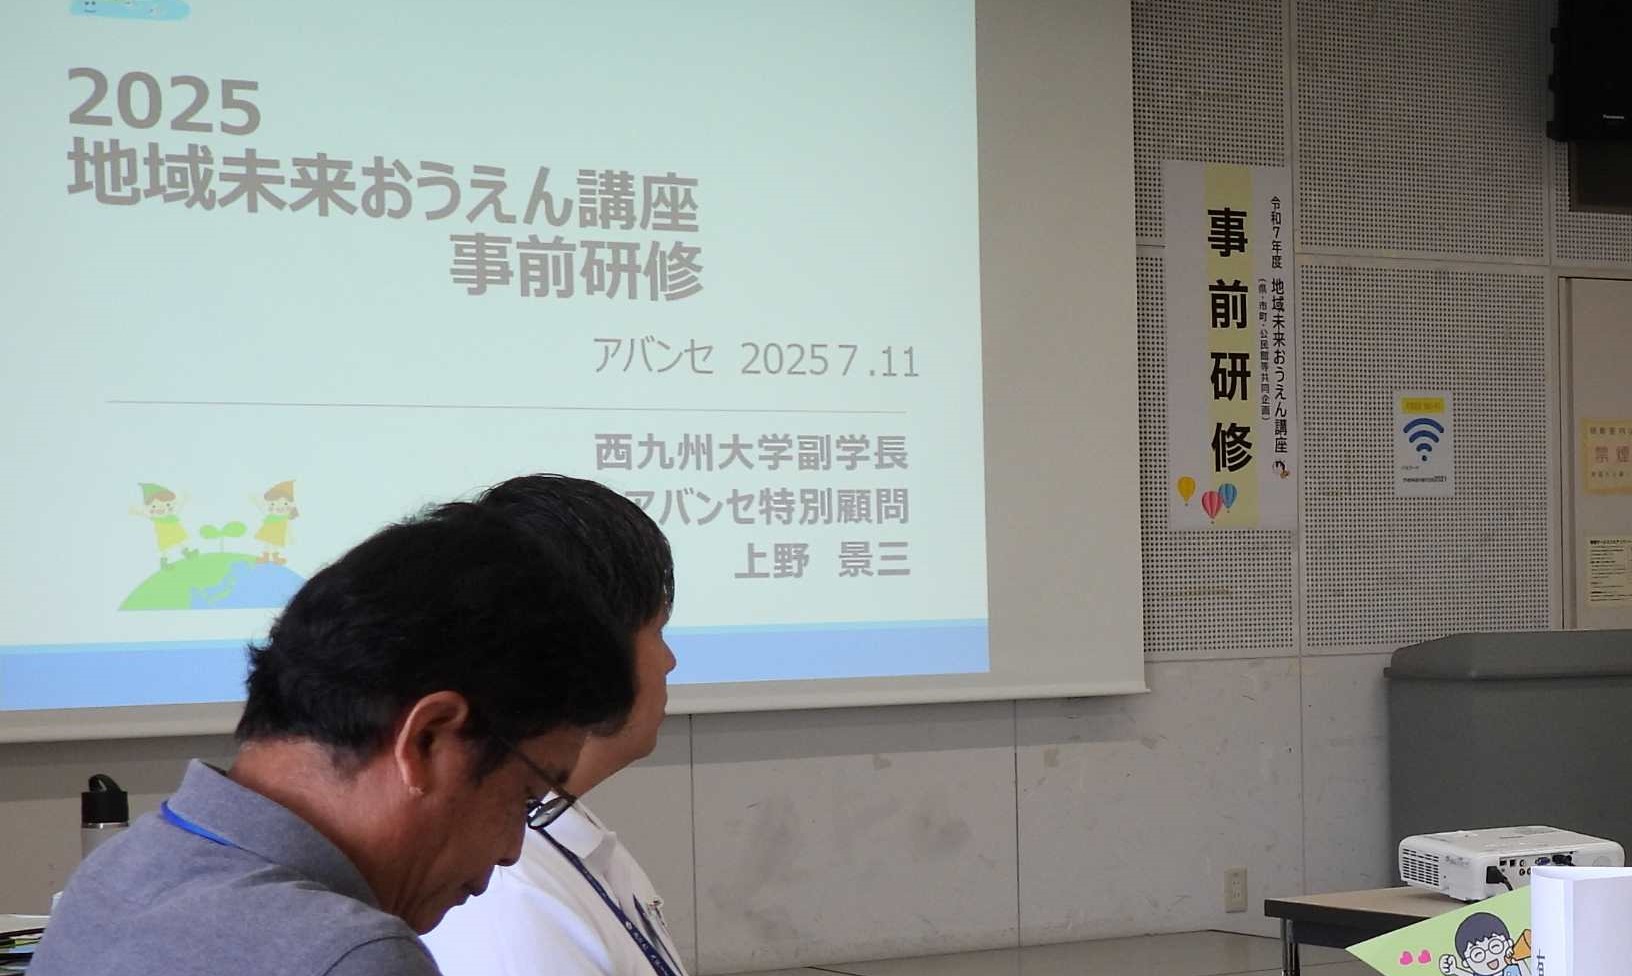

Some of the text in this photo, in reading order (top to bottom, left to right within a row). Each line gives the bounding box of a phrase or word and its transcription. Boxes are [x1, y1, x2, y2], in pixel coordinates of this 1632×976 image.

[67, 66, 261, 135] 2025
[66, 137, 700, 234] 地域未来おうえん講座
[449, 232, 704, 302] 事前研修
[593, 336, 714, 375] アバンセ
[1207, 206, 1253, 473] 事前研修
[1270, 195, 1288, 454] 令和7年度 地域未来おうえん講座
[594, 432, 909, 472] 西九州大学副学長
[624, 487, 910, 526] アバンセ特別顧問
[734, 541, 911, 579] 上野 景三
